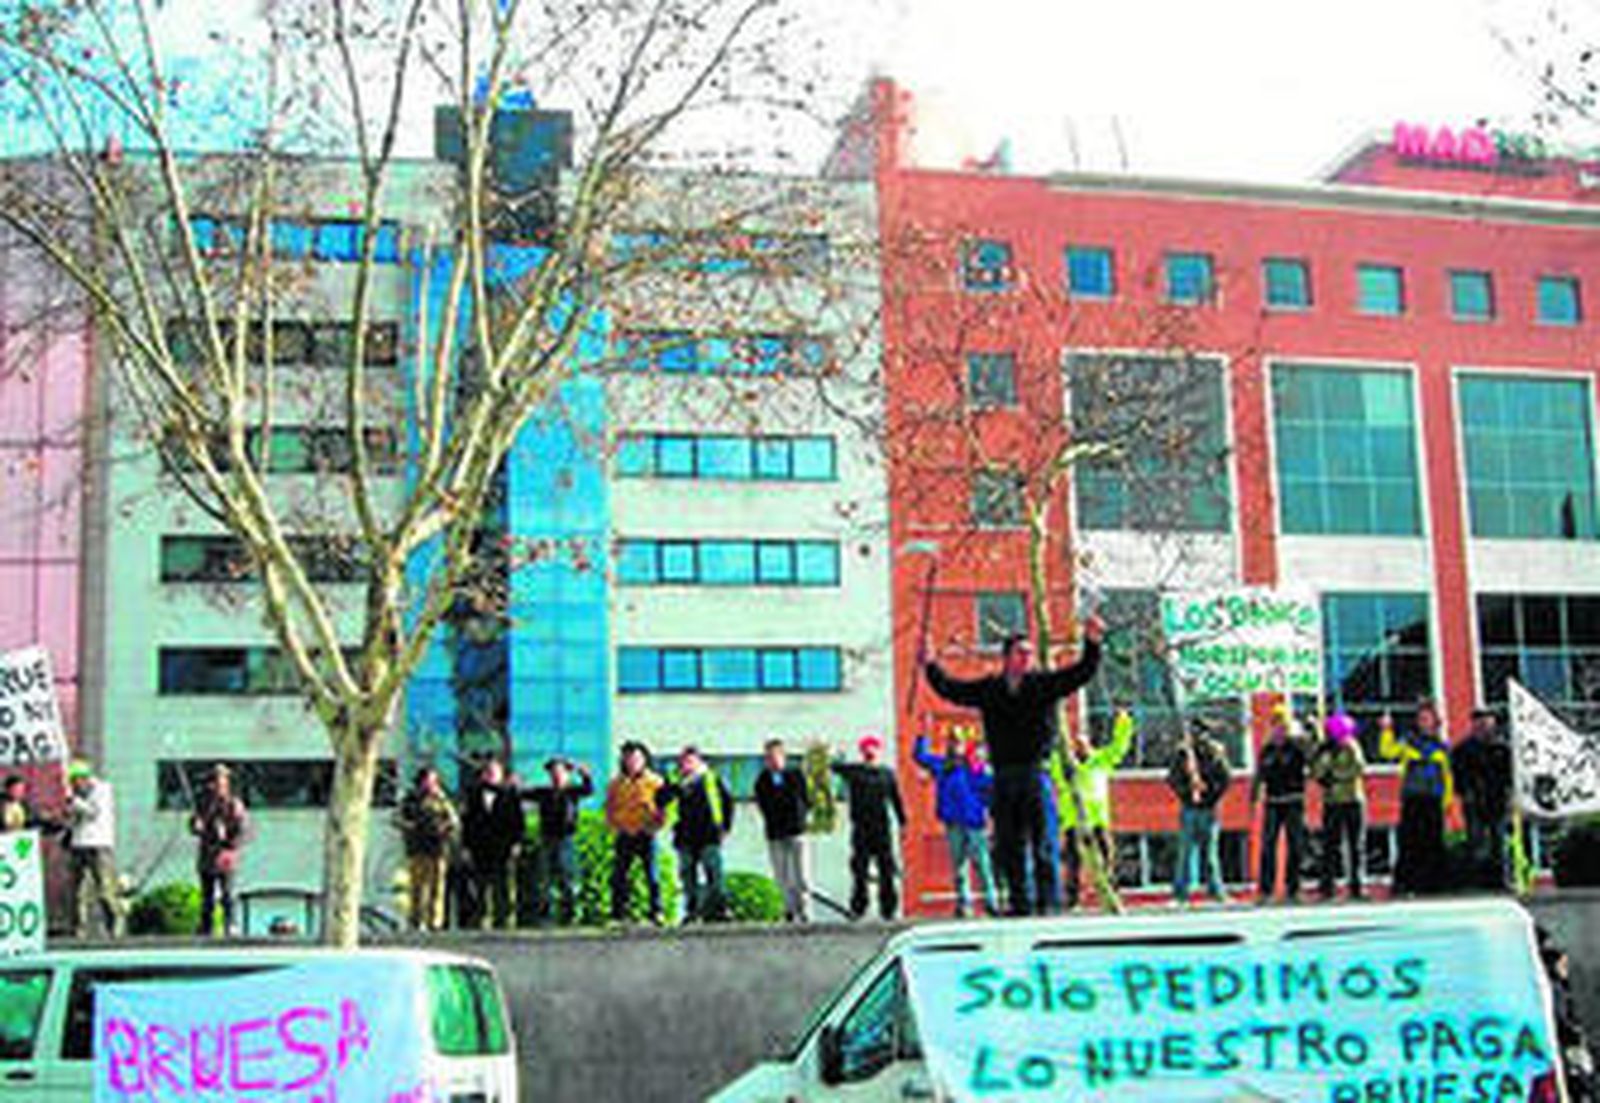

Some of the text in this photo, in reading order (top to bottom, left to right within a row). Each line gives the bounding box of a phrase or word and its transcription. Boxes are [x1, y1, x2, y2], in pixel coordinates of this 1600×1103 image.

[1121, 957, 1427, 1012] PEDIMOS
[105, 998, 370, 1094] BRUESA
[1400, 1016, 1547, 1064] PAGA
